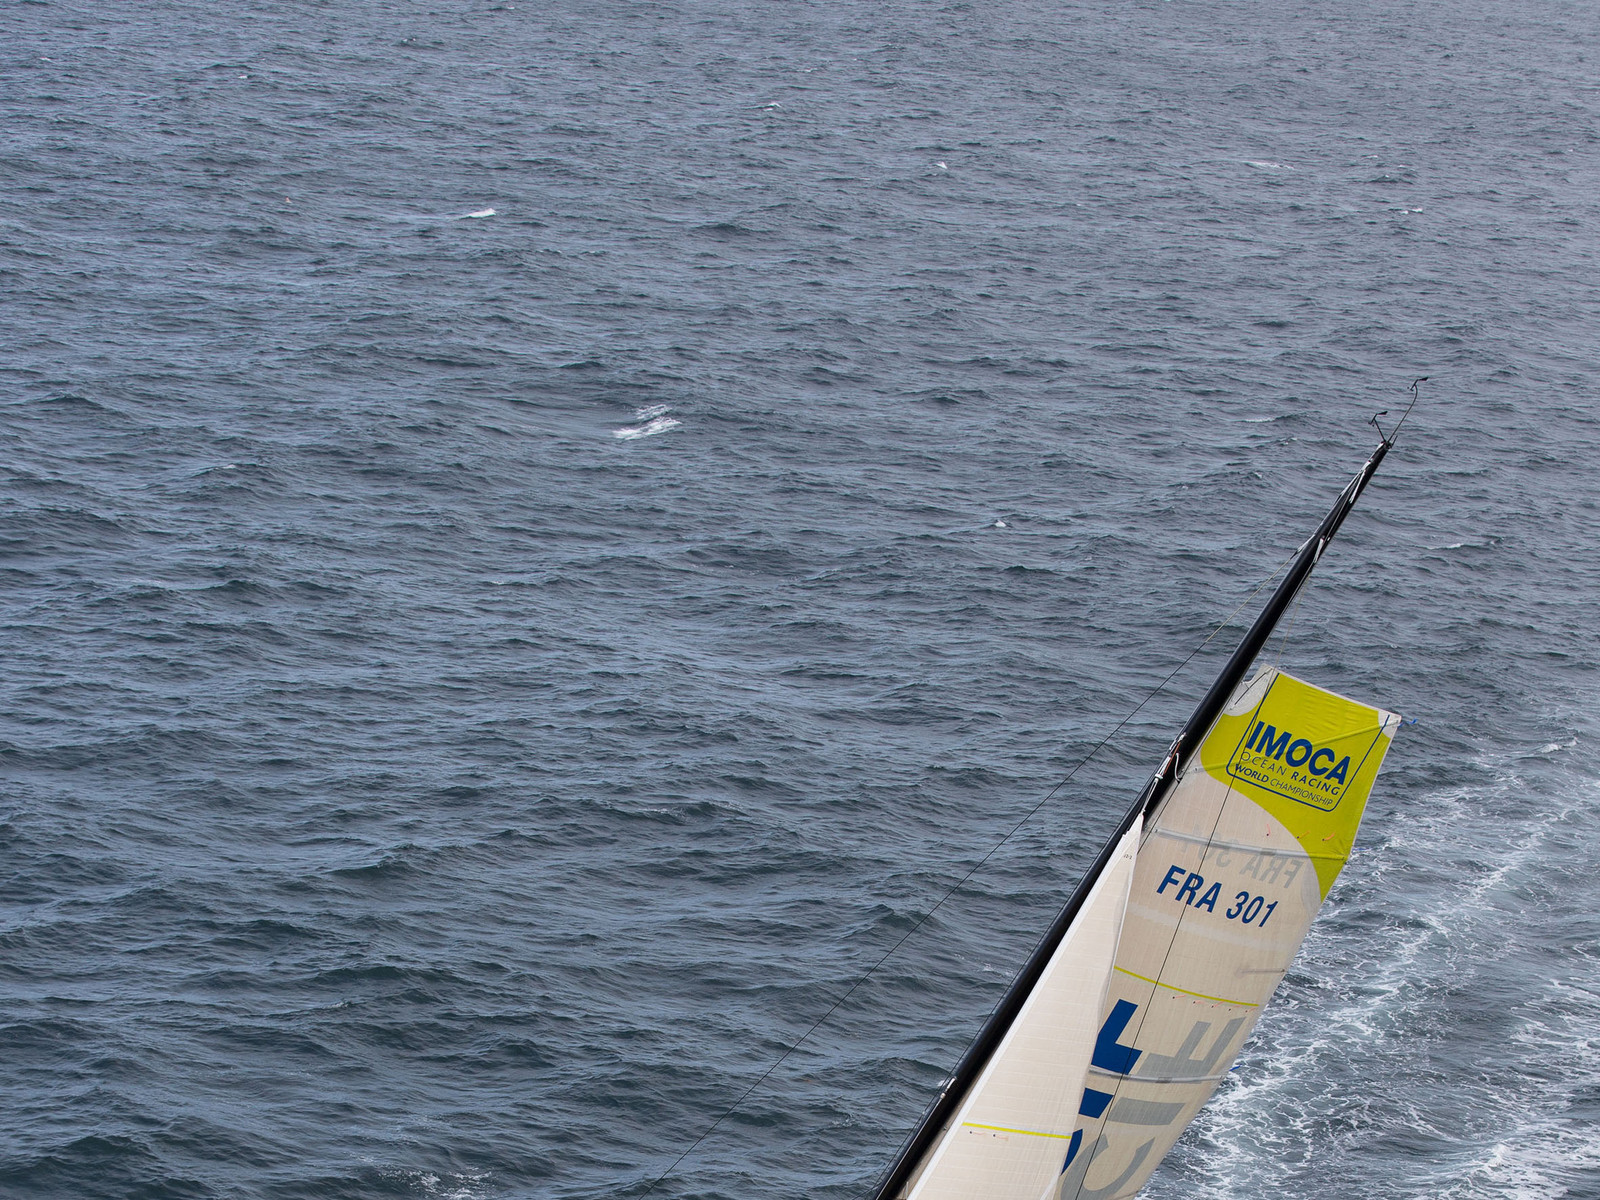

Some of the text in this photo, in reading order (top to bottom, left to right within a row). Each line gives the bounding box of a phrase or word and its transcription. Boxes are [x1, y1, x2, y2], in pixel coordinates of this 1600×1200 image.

[1241, 752, 1341, 795] OCEAN RACING
[1246, 721, 1351, 785] IMOCA
[1236, 764, 1333, 806] WORLD CHAMPIONSHIP
[1156, 864, 1279, 927] FRA 301
